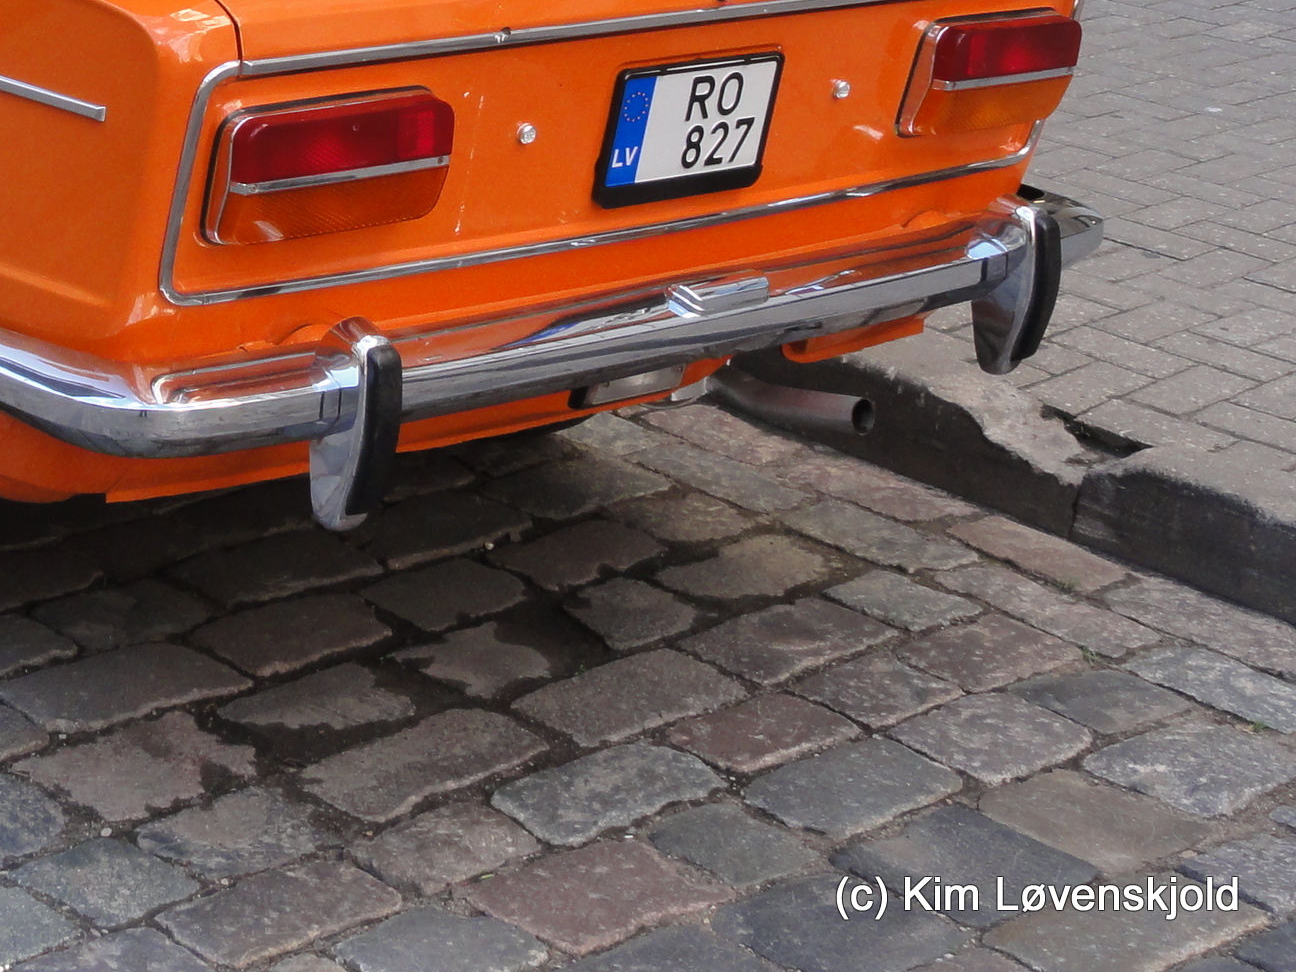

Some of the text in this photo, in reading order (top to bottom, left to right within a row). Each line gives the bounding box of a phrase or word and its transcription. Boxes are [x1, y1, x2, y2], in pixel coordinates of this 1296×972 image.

[684, 71, 744, 121] RO
[611, 145, 638, 168] LV
[680, 116, 756, 169] 827
